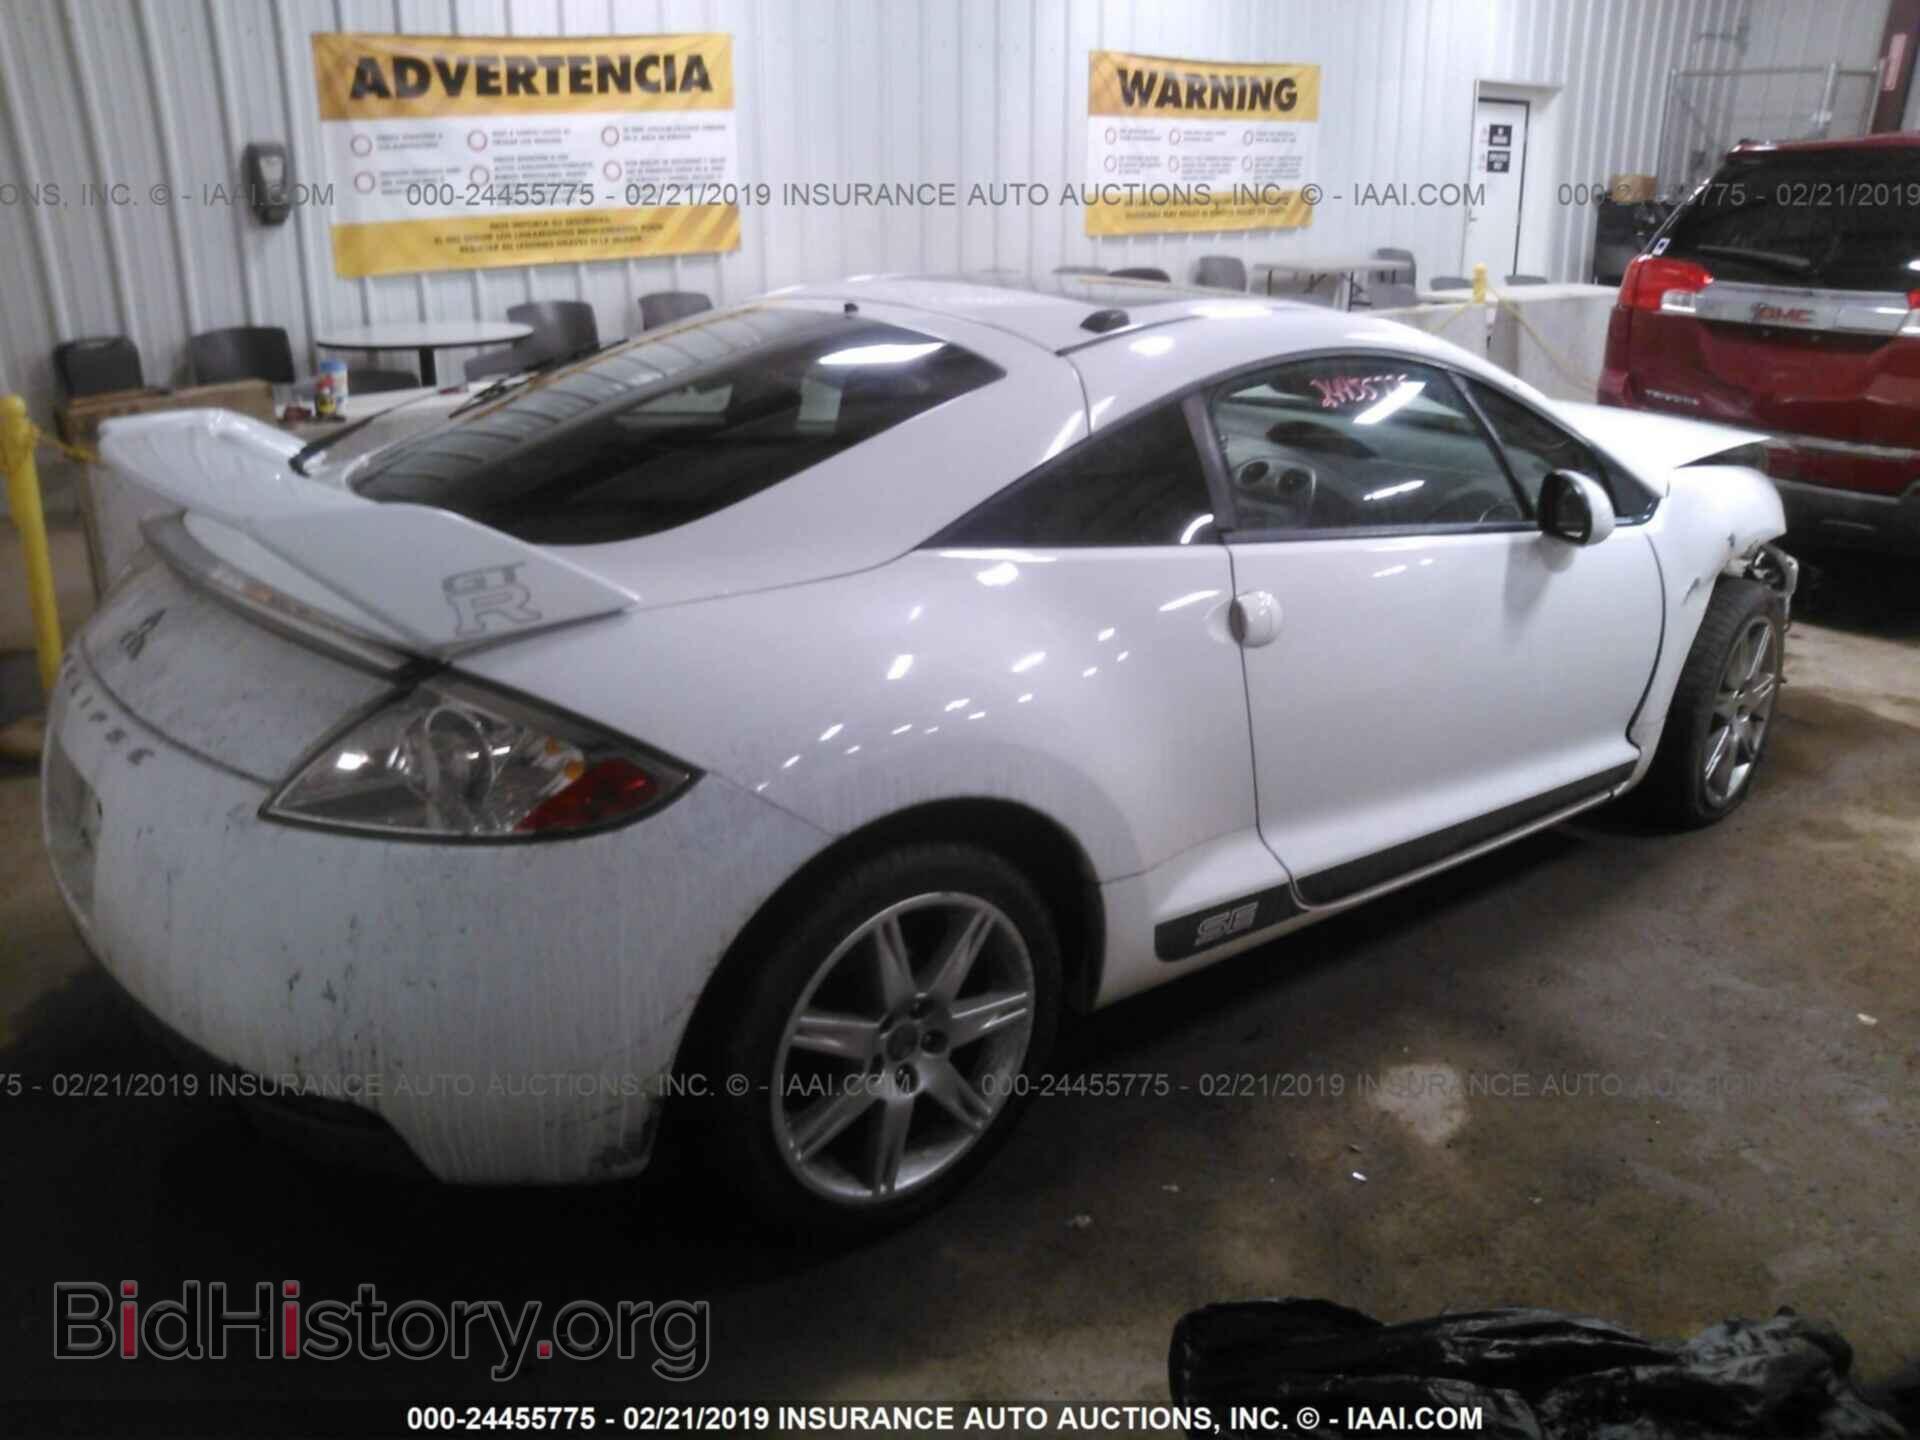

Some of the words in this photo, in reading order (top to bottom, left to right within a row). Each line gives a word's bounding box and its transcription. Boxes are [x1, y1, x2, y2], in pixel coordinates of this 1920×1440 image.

[350, 53, 712, 99] ADVERTENCIA
[1117, 67, 1298, 112] WARNING
[1752, 303, 1816, 325] GMC
